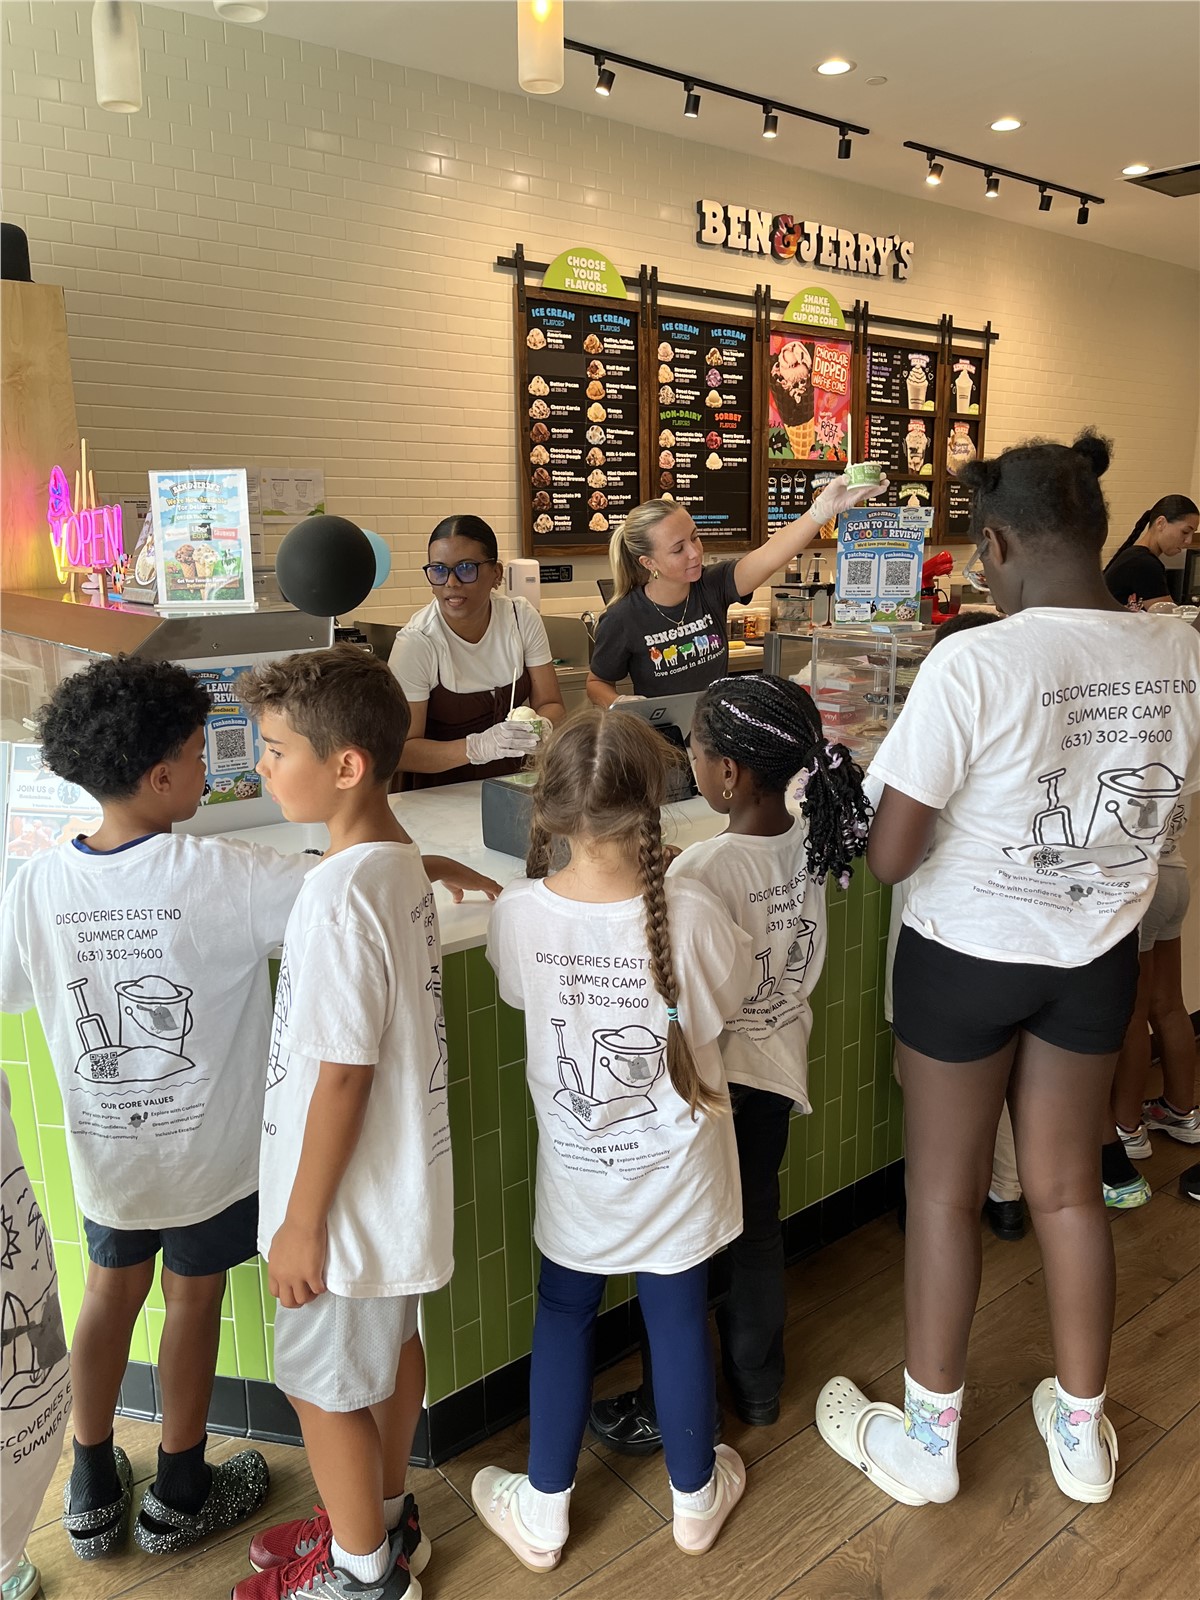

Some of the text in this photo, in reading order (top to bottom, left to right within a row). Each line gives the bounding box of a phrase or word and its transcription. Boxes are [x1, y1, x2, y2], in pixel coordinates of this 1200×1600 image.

[567, 255, 606, 271] CHOOSE
[572, 267, 601, 281] YOUR
[564, 278, 608, 293] FLAVORS
[803, 294, 830, 307] SHAKE,
[531, 307, 575, 321] ICE CREAM
[801, 303, 832, 317] SUNDAE,
[542, 318, 565, 327] FLAVORS
[589, 314, 630, 327] ICE CREAM
[792, 311, 838, 327] CUP OR CONE
[600, 324, 620, 333] FLAVORS
[662, 322, 699, 335] ICE CREAM
[711, 329, 746, 341] ICE CREAM
[816, 346, 849, 366] CHOCOLATE
[814, 357, 847, 382] DIPPED
[832, 379, 846, 392] CONE
[660, 410, 702, 421] NON-DAIRY
[715, 413, 742, 422] SORBET
[848, 521, 898, 532] SCAN TO LEA
[65, 504, 120, 568] OPEN
[844, 530, 921, 541] A GOOGLE REVIEW!
[847, 551, 874, 560] patchogue
[669, 665, 689, 676] comes
[689, 660, 697, 668] in
[697, 656, 706, 666] all
[1042, 679, 1197, 707] DISCOVERIES EAST END
[824, 714, 837, 722] vinyl
[1066, 704, 1172, 725] SUMMER CAMP
[1061, 729, 1173, 751] (631) 302-9600
[16, 785, 35, 793] JOIN
[998, 870, 1012, 880] Play
[1012, 874, 1028, 882] with
[749, 885, 788, 903] DISCOVER
[988, 880, 1006, 889] Grow
[1024, 887, 1063, 899] Confidence
[767, 898, 797, 917] SUMMR
[1034, 899, 1074, 914] Community
[55, 908, 182, 925] DISCOVERIES EAST END
[77, 928, 159, 943] SUMMER CAMP
[77, 949, 163, 963] (631) 302-9600
[536, 952, 611, 969] DISCOVERIES
[614, 957, 645, 970] EAST
[559, 975, 647, 989] SUMMER CAMP
[558, 991, 649, 1008] (631) 302-9600
[772, 999, 788, 1011] ALUES
[101, 1096, 174, 1110] OUR CORE VALUES
[262, 1120, 277, 1136] ND
[554, 1139, 565, 1147] Play
[590, 1141, 640, 1154] ORE VALUES
[572, 1155, 599, 1163] Confidence
[648, 1149, 671, 1158] Curiosity
[579, 1166, 608, 1176] Community
[13, 1410, 62, 1464] SUMMER
